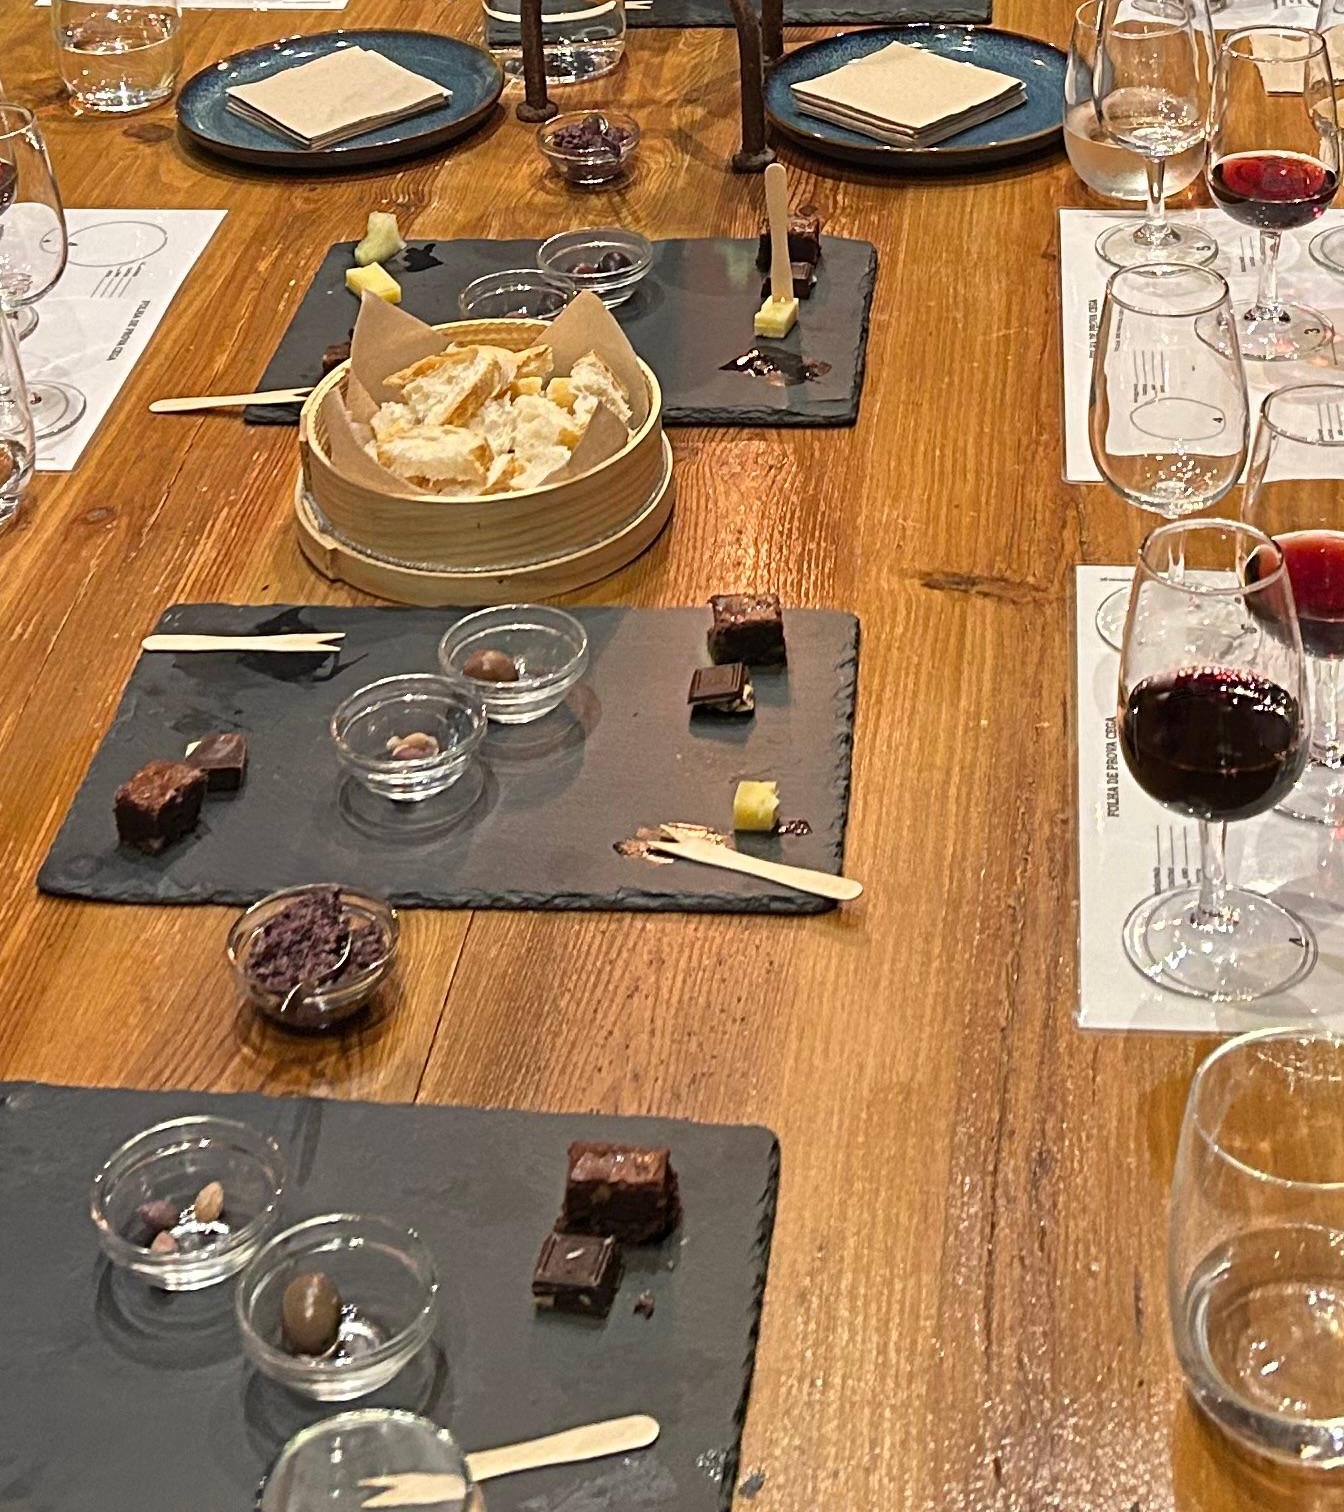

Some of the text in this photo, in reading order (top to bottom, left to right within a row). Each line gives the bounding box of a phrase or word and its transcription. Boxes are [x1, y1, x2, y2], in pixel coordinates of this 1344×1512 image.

[1105, 716, 1119, 818] FOLHA DE PROVA CEGA
